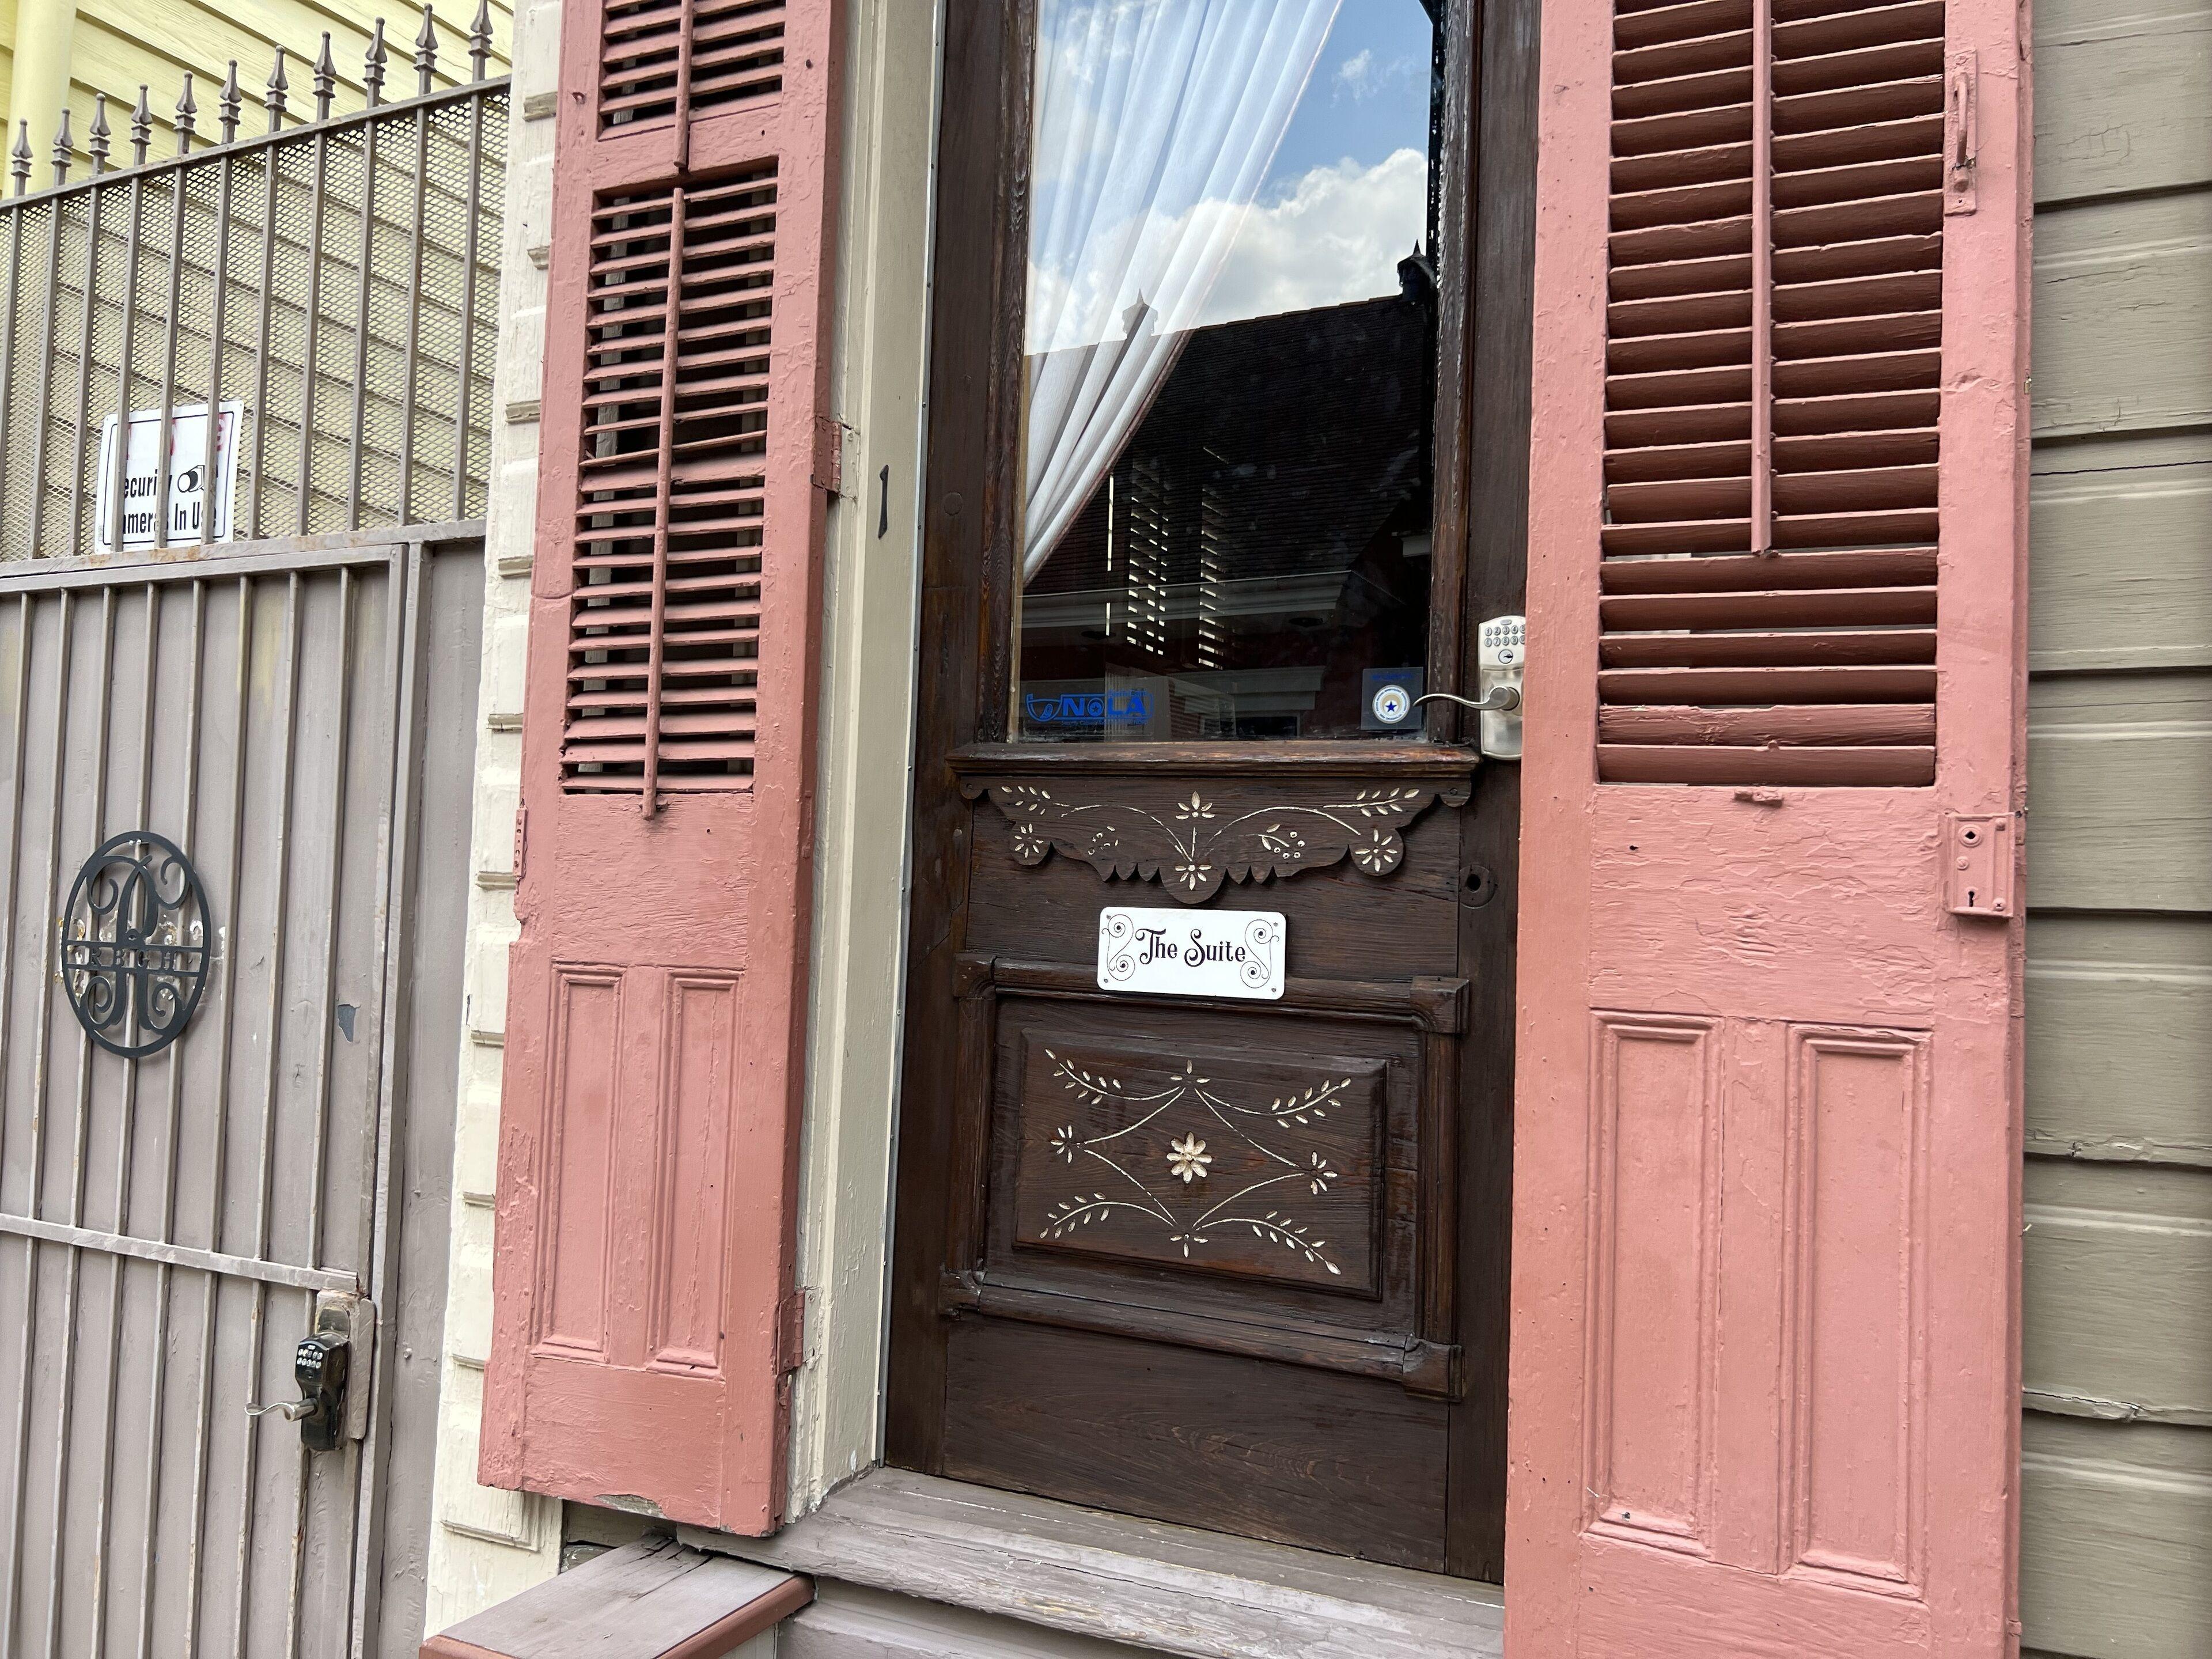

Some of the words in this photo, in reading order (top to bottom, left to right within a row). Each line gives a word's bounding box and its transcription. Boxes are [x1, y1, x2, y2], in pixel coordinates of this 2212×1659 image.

[124, 468, 173, 499] ecuri
[175, 503, 187, 531] In
[1135, 928, 1178, 965] The
[1184, 929, 1246, 967] Suite
